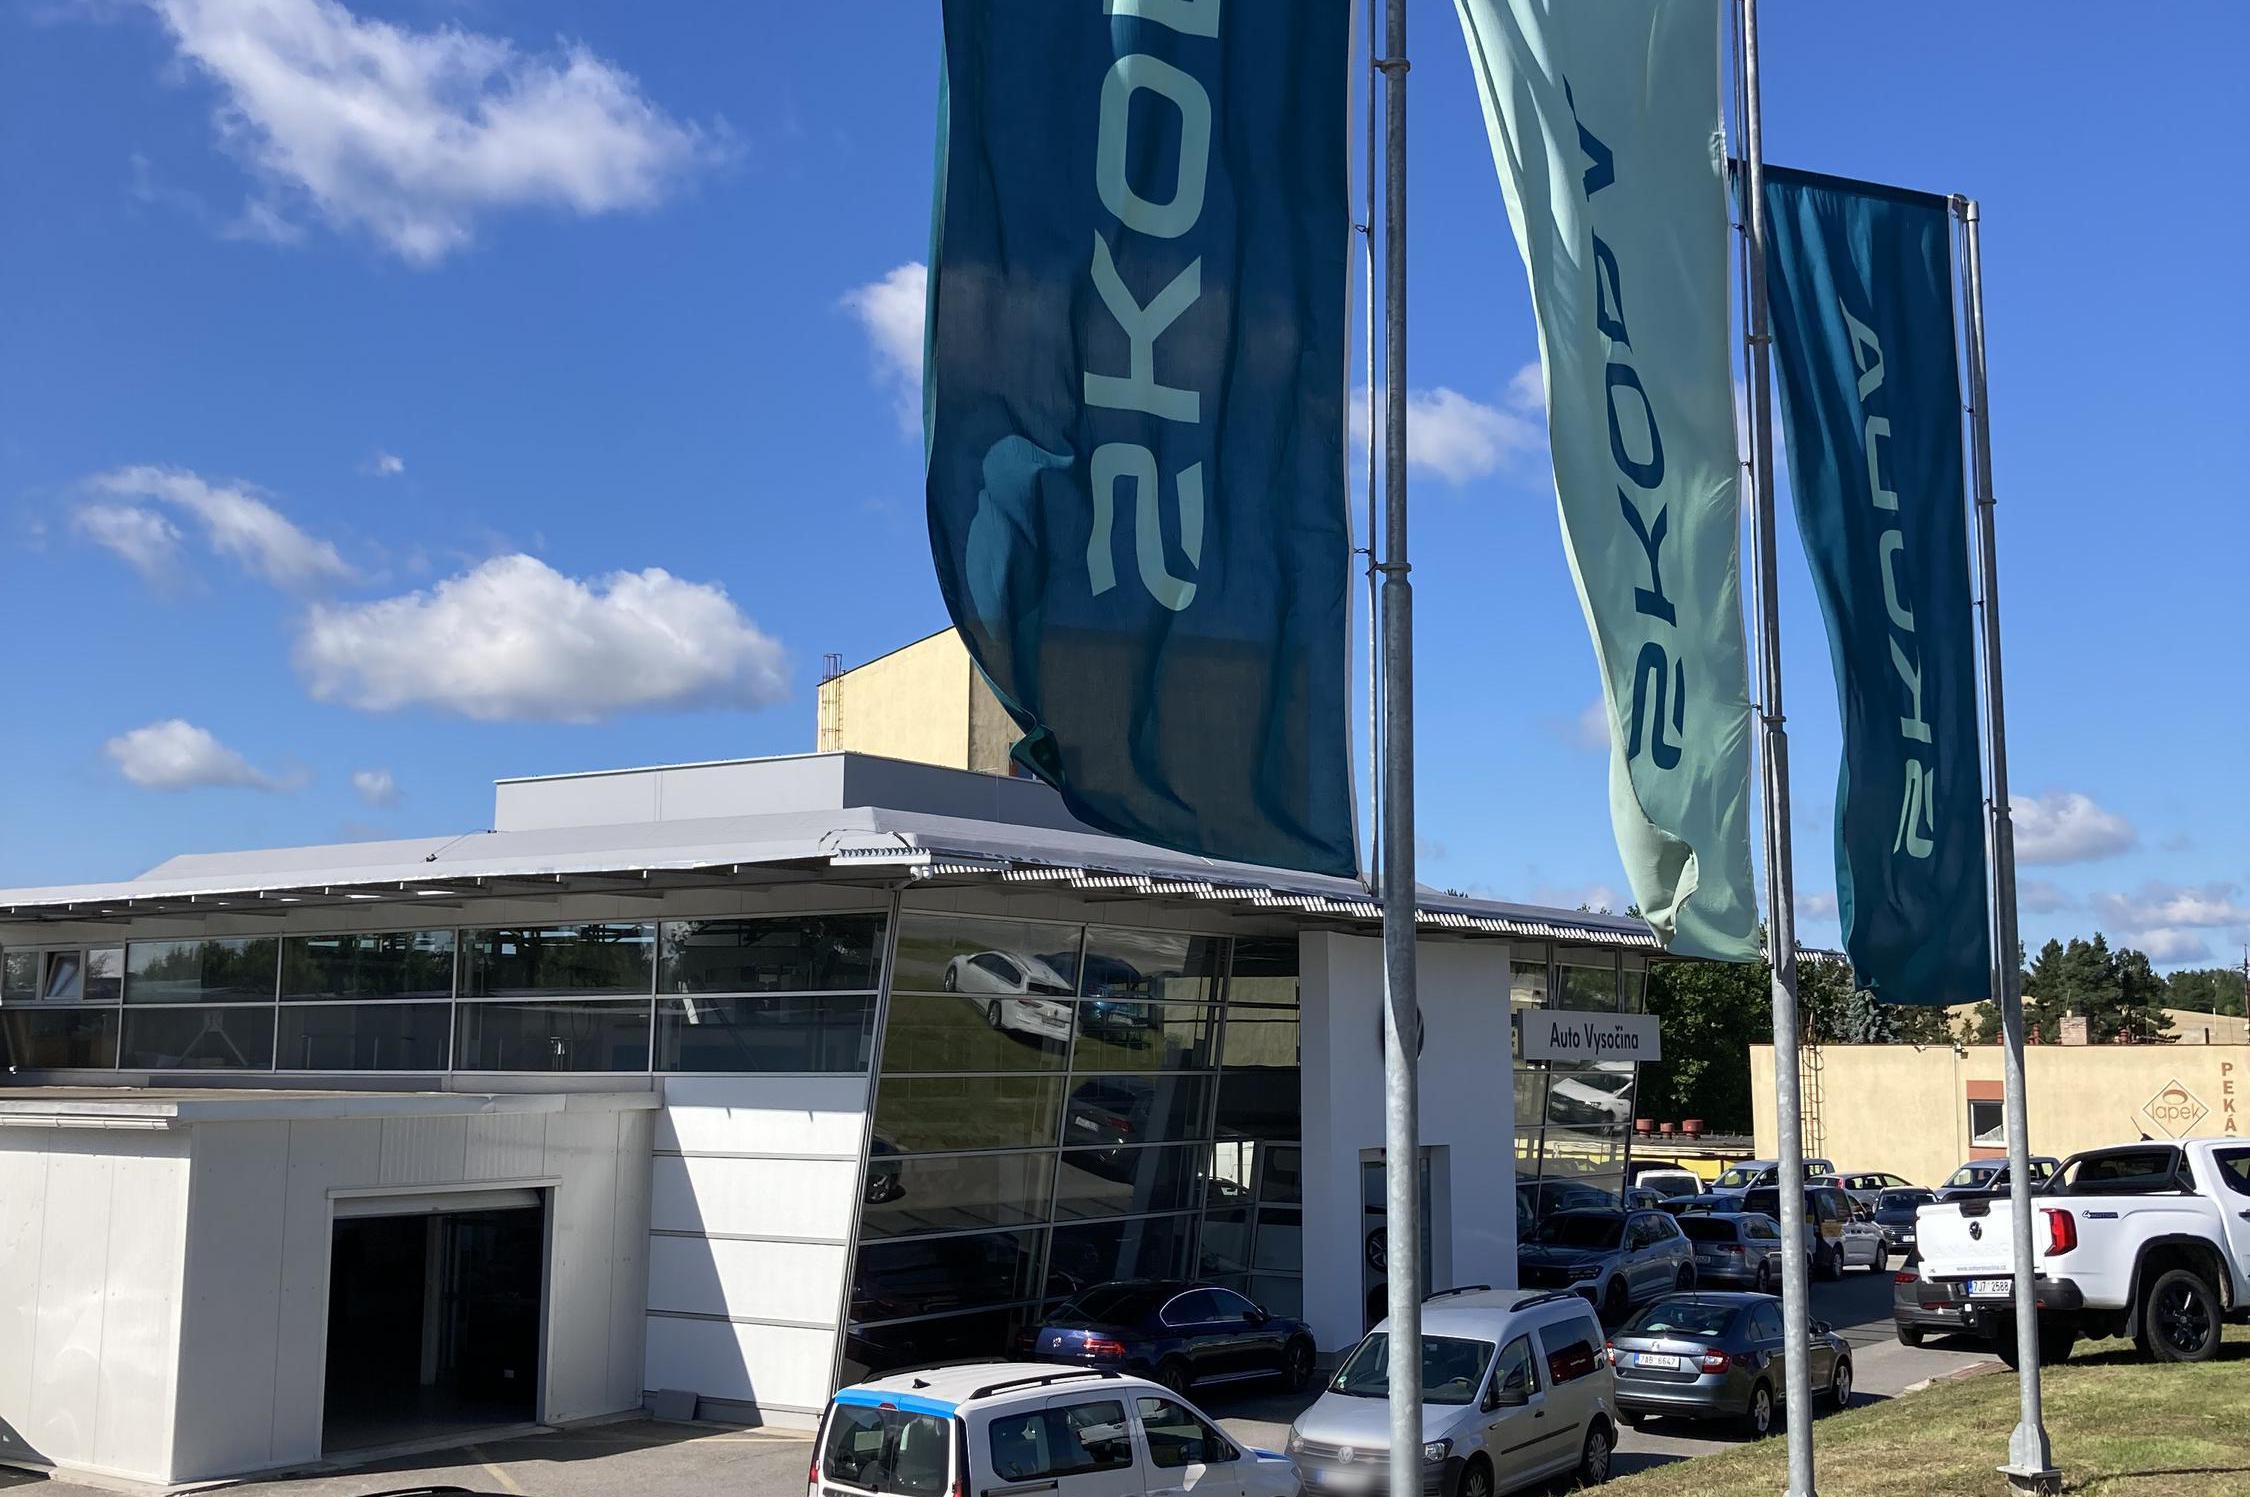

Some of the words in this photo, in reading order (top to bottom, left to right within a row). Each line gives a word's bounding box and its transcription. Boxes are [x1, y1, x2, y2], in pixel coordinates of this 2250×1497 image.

[1549, 1021, 1581, 1049] Auto
[1584, 1023, 1639, 1055] Vysočina
[2220, 1061, 2238, 1138] PEKÁ
